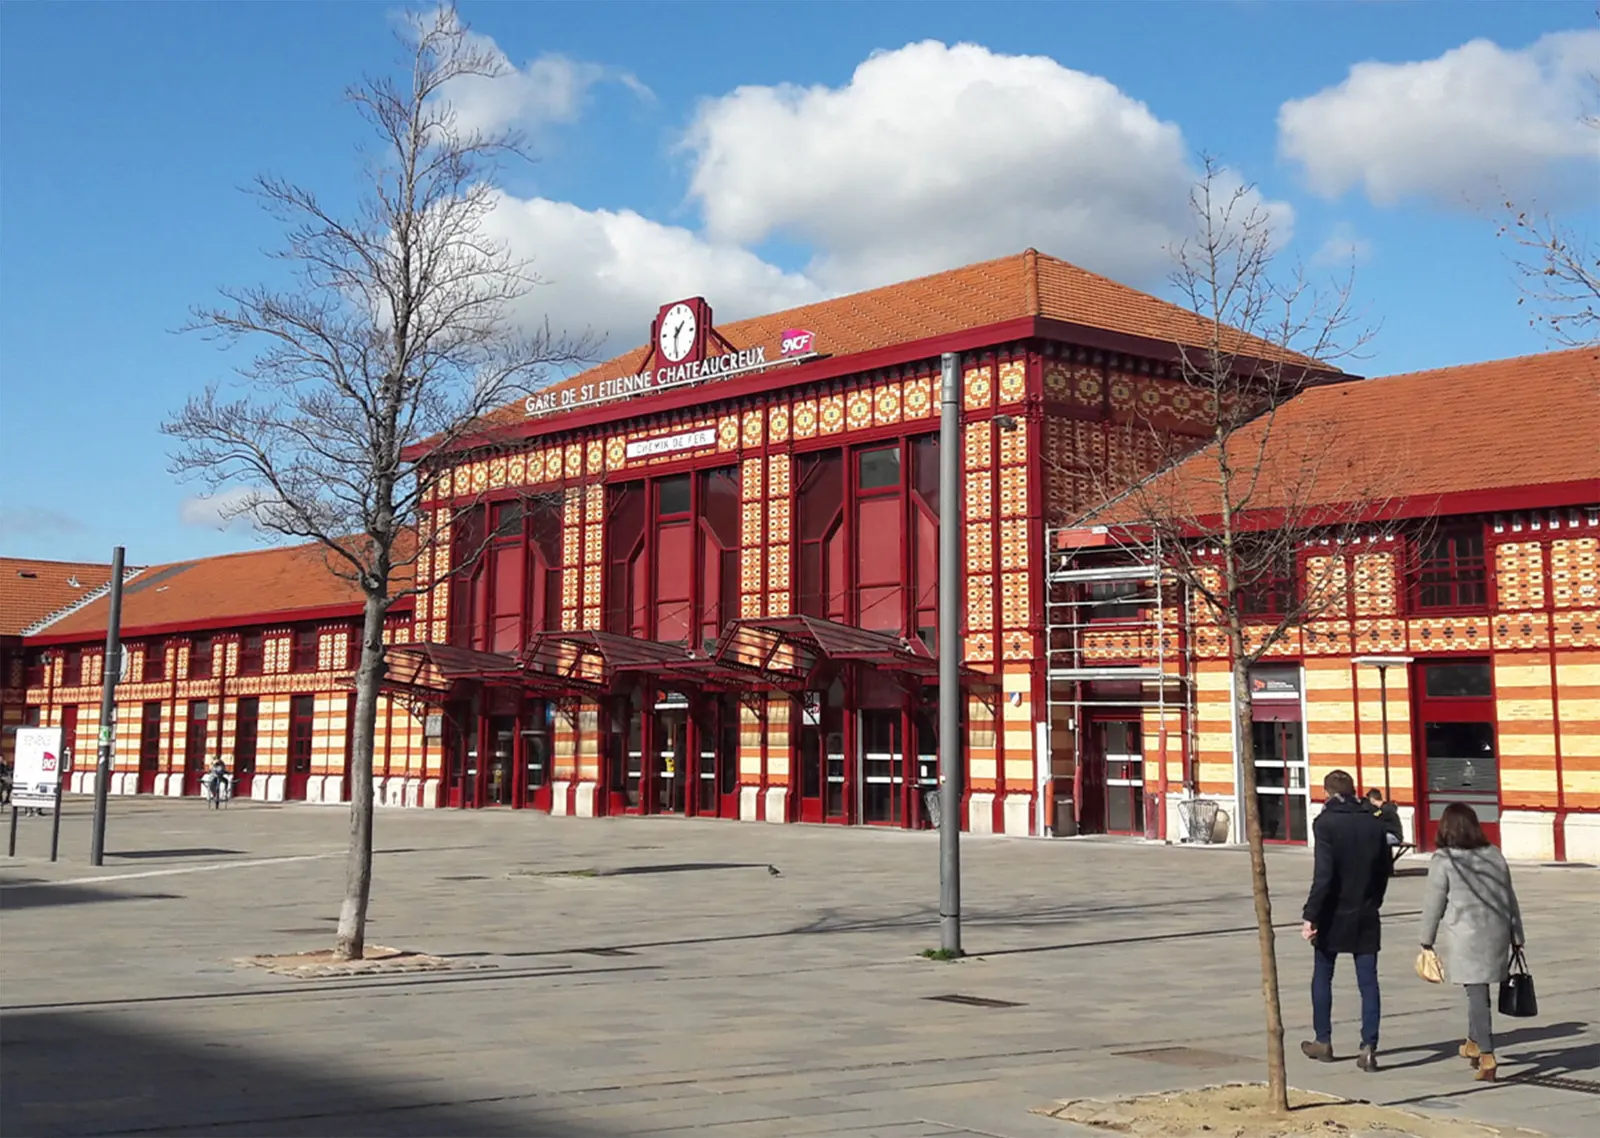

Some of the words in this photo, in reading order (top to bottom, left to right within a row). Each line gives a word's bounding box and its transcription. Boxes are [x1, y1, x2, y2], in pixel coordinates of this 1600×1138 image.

[781, 334, 811, 354] SNCF
[525, 394, 557, 413] GARE
[561, 388, 577, 406] DE
[580, 384, 595, 401] ST
[599, 371, 652, 398] ETIENNE
[656, 346, 766, 385] CHATEAUCREUX
[636, 440, 669, 454] CHEMIN
[672, 436, 684, 448] DE
